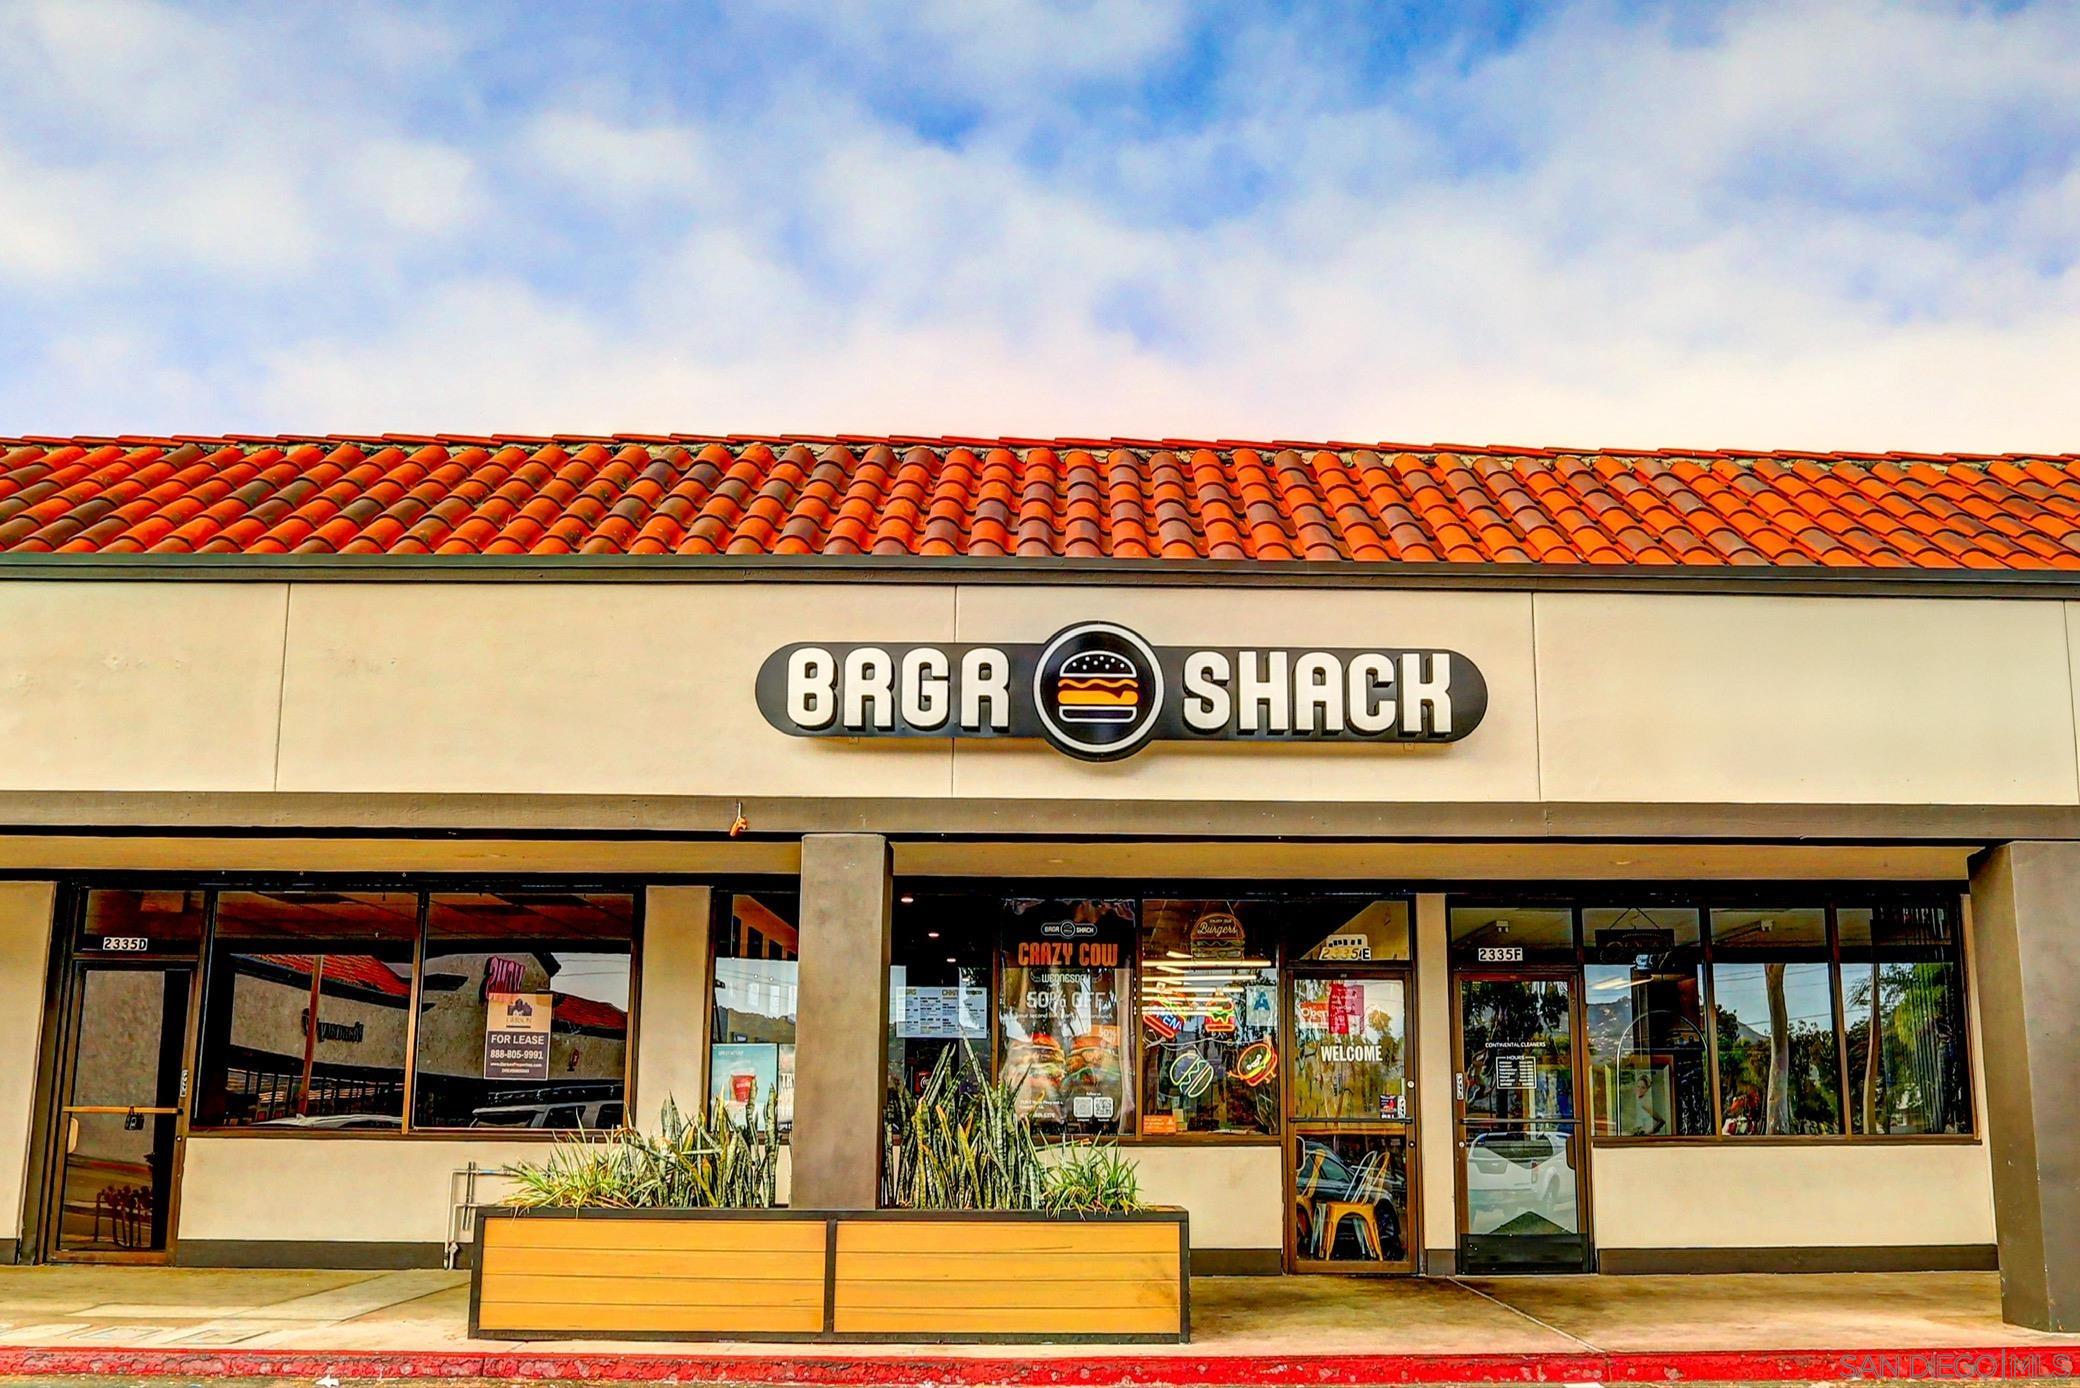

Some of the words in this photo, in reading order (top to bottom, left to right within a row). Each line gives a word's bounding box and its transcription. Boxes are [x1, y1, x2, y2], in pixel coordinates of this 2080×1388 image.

[787, 647, 1010, 730] BRGR
[1183, 650, 1452, 735] SHACK
[1197, 921, 1238, 937] Burgers
[104, 938, 147, 950] 2335D
[1018, 943, 1073, 965] CRAZY
[1079, 943, 1118, 966] COW
[1320, 947, 1370, 960] 2335E
[1479, 948, 1521, 961] 2335F
[1253, 991, 1271, 1010] A
[491, 1034, 511, 1044] FOR
[513, 1035, 545, 1045] LEASE
[1485, 1041, 1520, 1049] CONTINENTAL
[1320, 1045, 1384, 1062] WELCOME
